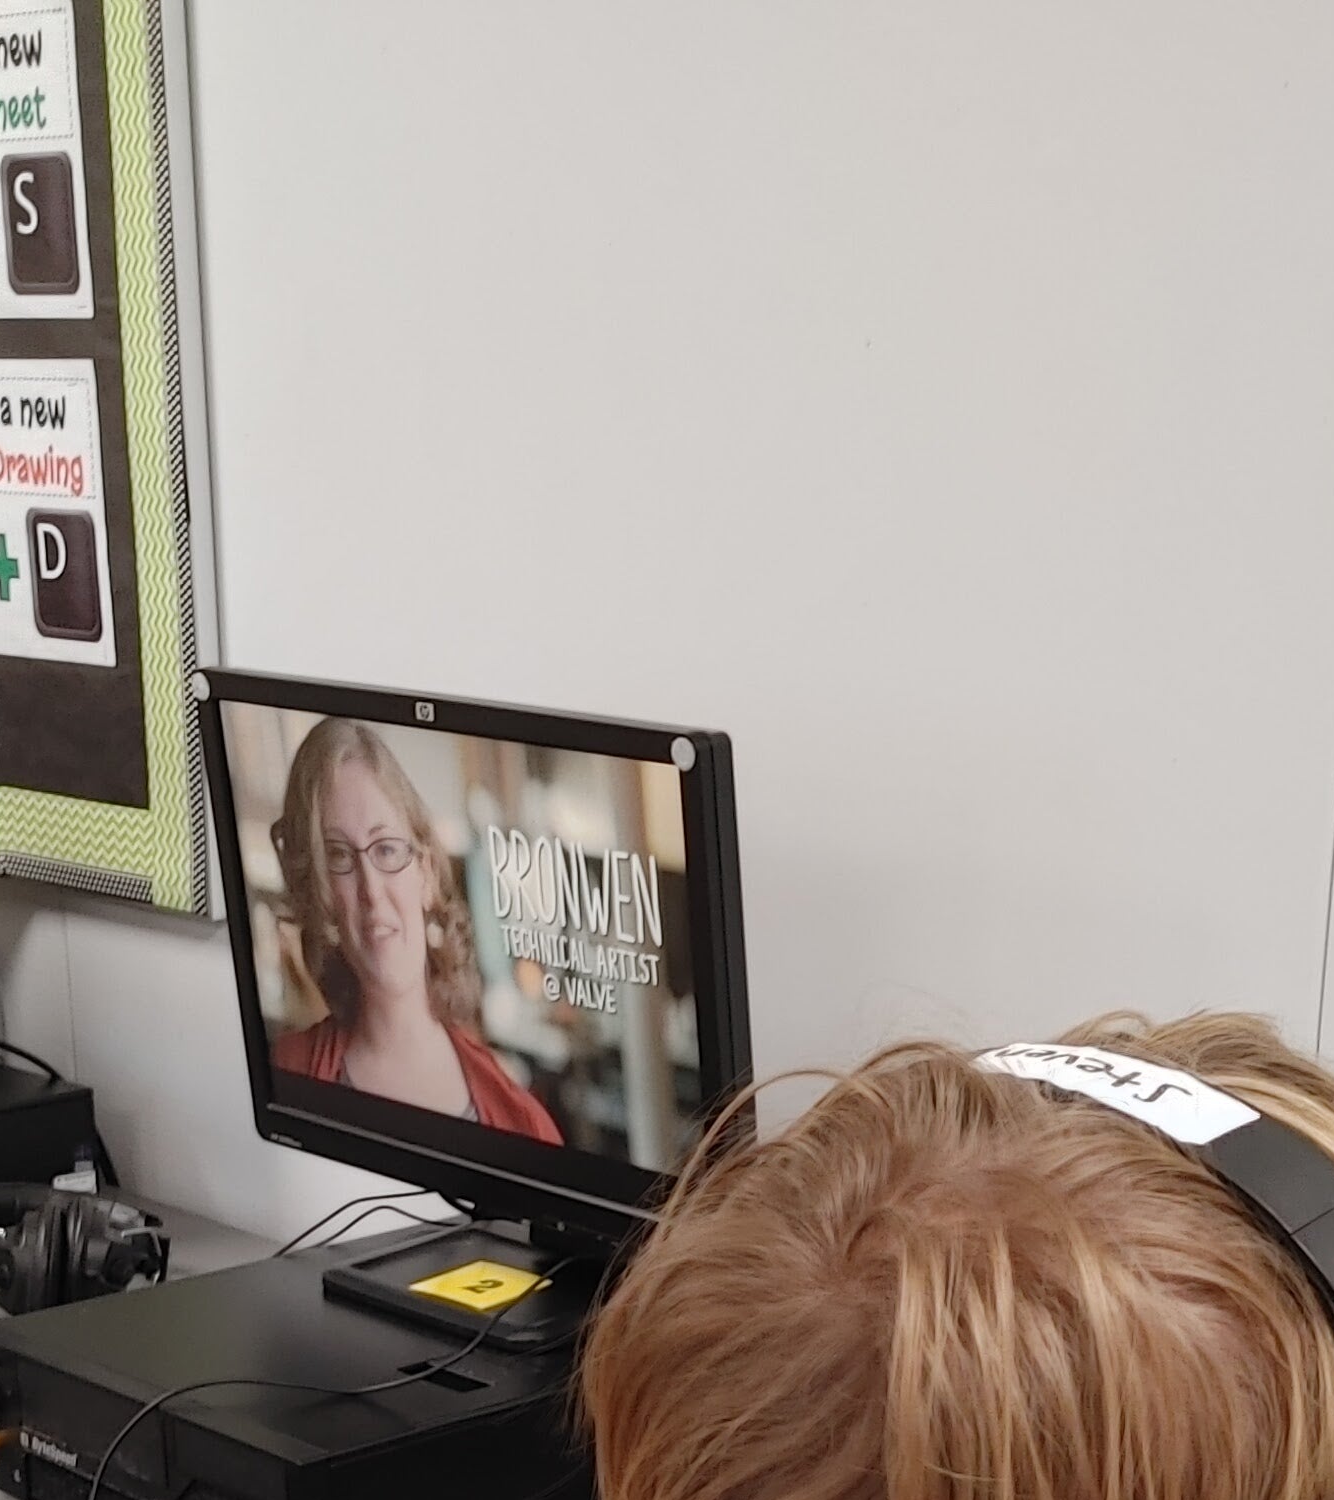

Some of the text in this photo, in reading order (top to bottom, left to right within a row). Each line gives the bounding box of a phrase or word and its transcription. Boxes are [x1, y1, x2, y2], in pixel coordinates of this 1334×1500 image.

[14, 172, 38, 236] S
[0, 394, 13, 425] a
[20, 393, 66, 430] new
[35, 522, 67, 580] D
[487, 824, 663, 947] BRONWEN
[501, 924, 660, 986] TECHNICAL ARTIST
[543, 973, 617, 1014] @ VALVE
[464, 1276, 506, 1296] 2
